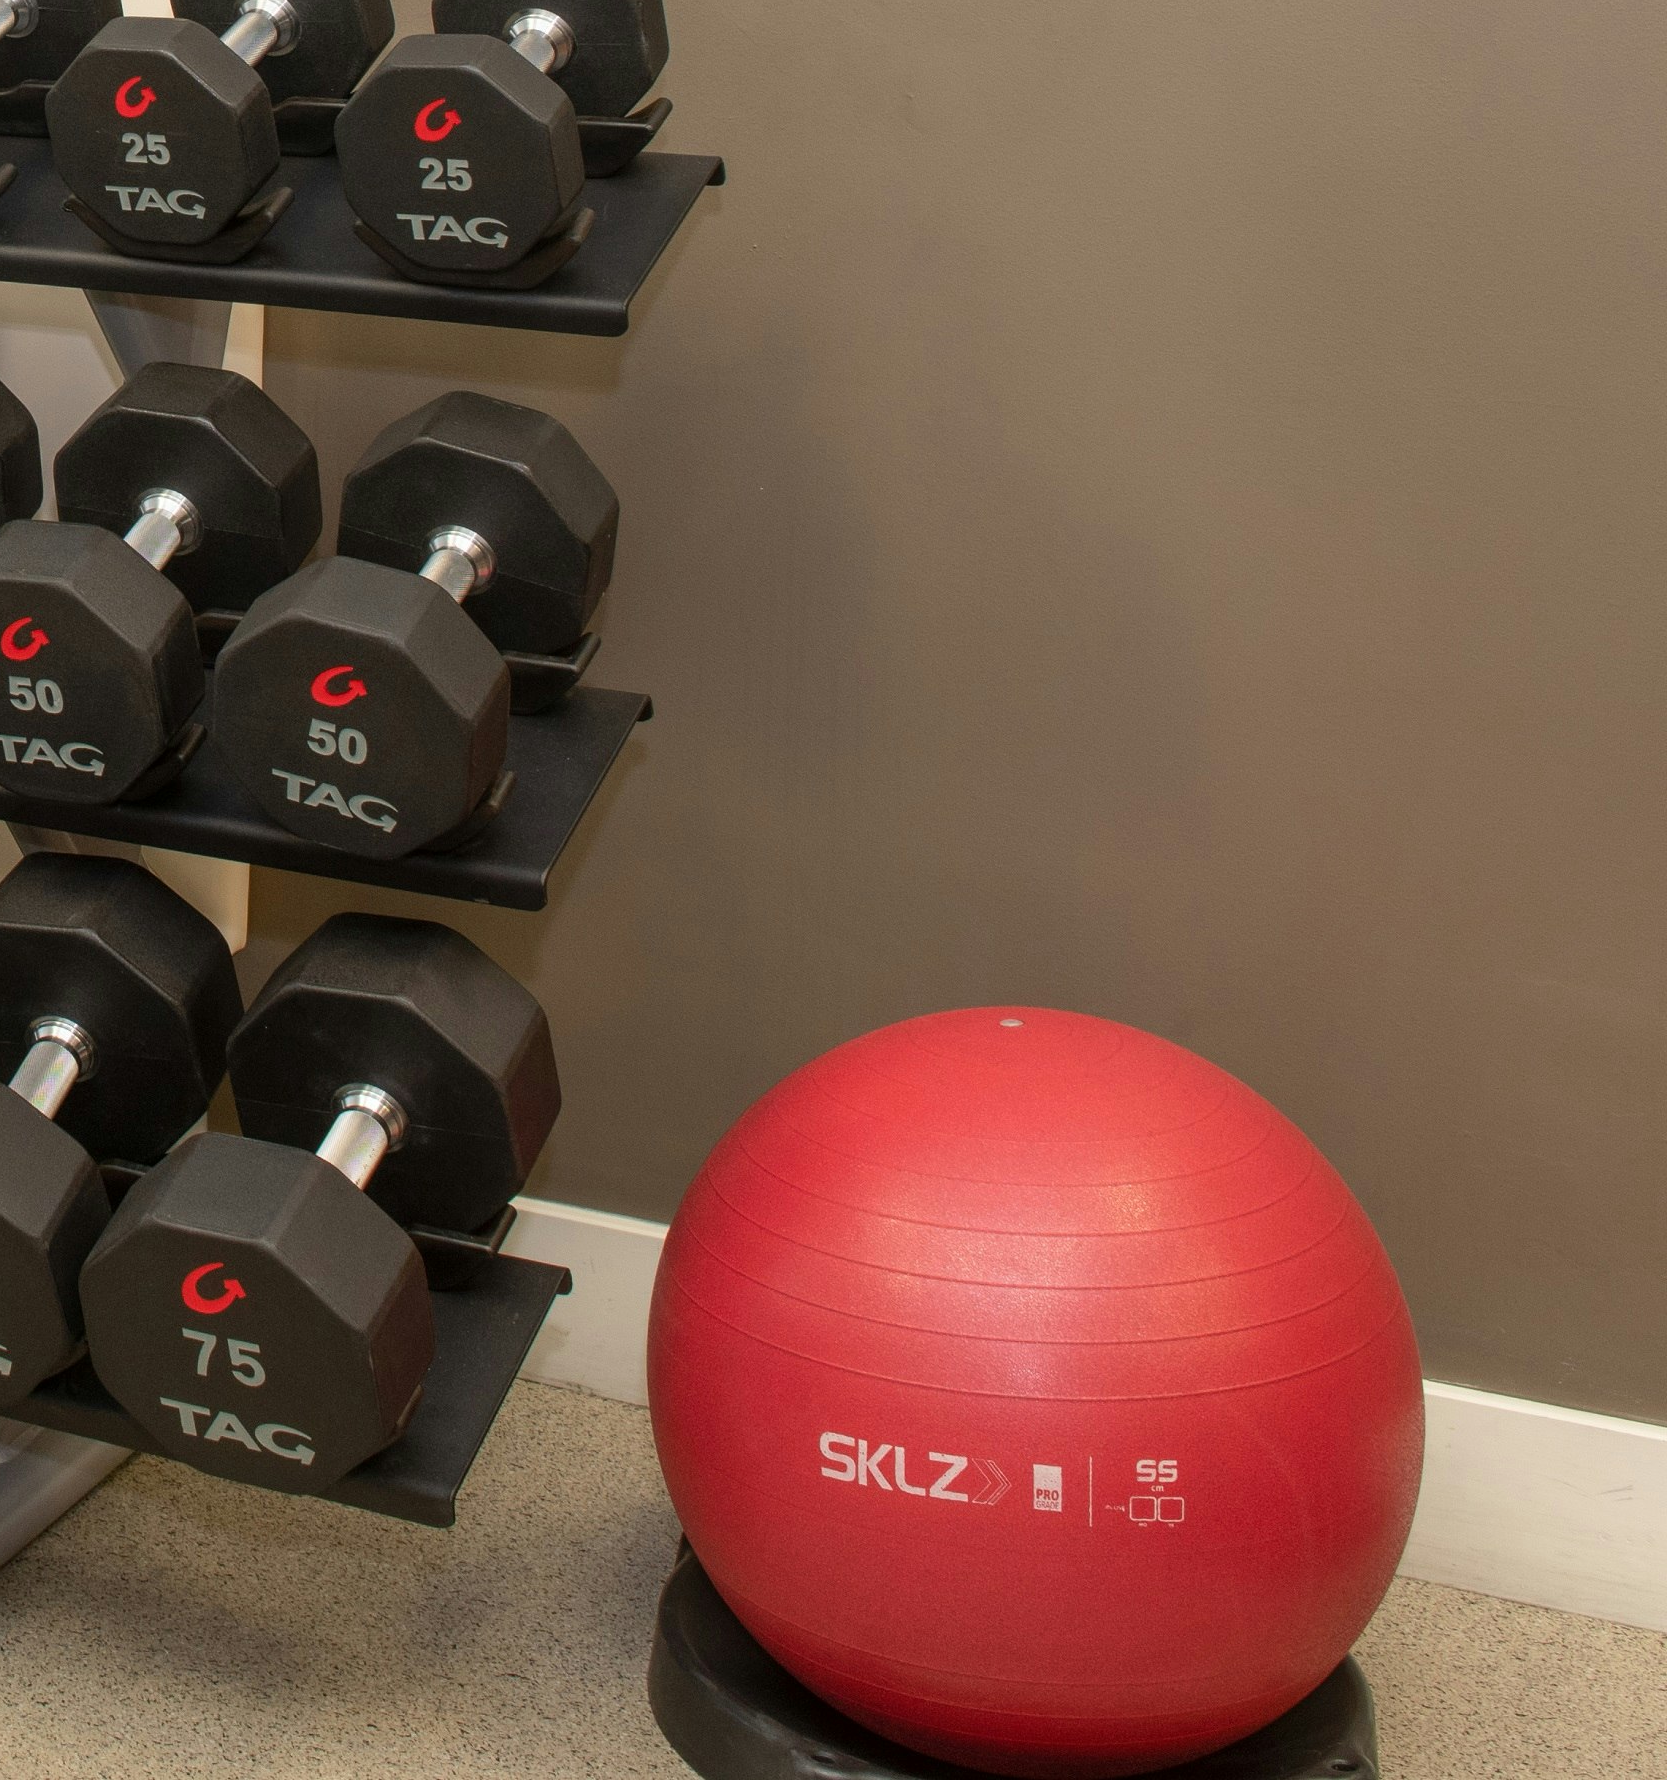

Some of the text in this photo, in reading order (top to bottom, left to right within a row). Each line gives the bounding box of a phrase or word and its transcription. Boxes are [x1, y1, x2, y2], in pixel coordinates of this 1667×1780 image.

[419, 158, 472, 191] 25
[397, 214, 508, 248] TAG
[9, 676, 63, 713] 50
[182, 1328, 265, 1386] 75
[160, 1397, 315, 1466] TAG
[819, 1431, 968, 1504] SKLZ
[1036, 1488, 1059, 1500] PRO
[1036, 1500, 1060, 1510] GRADE
